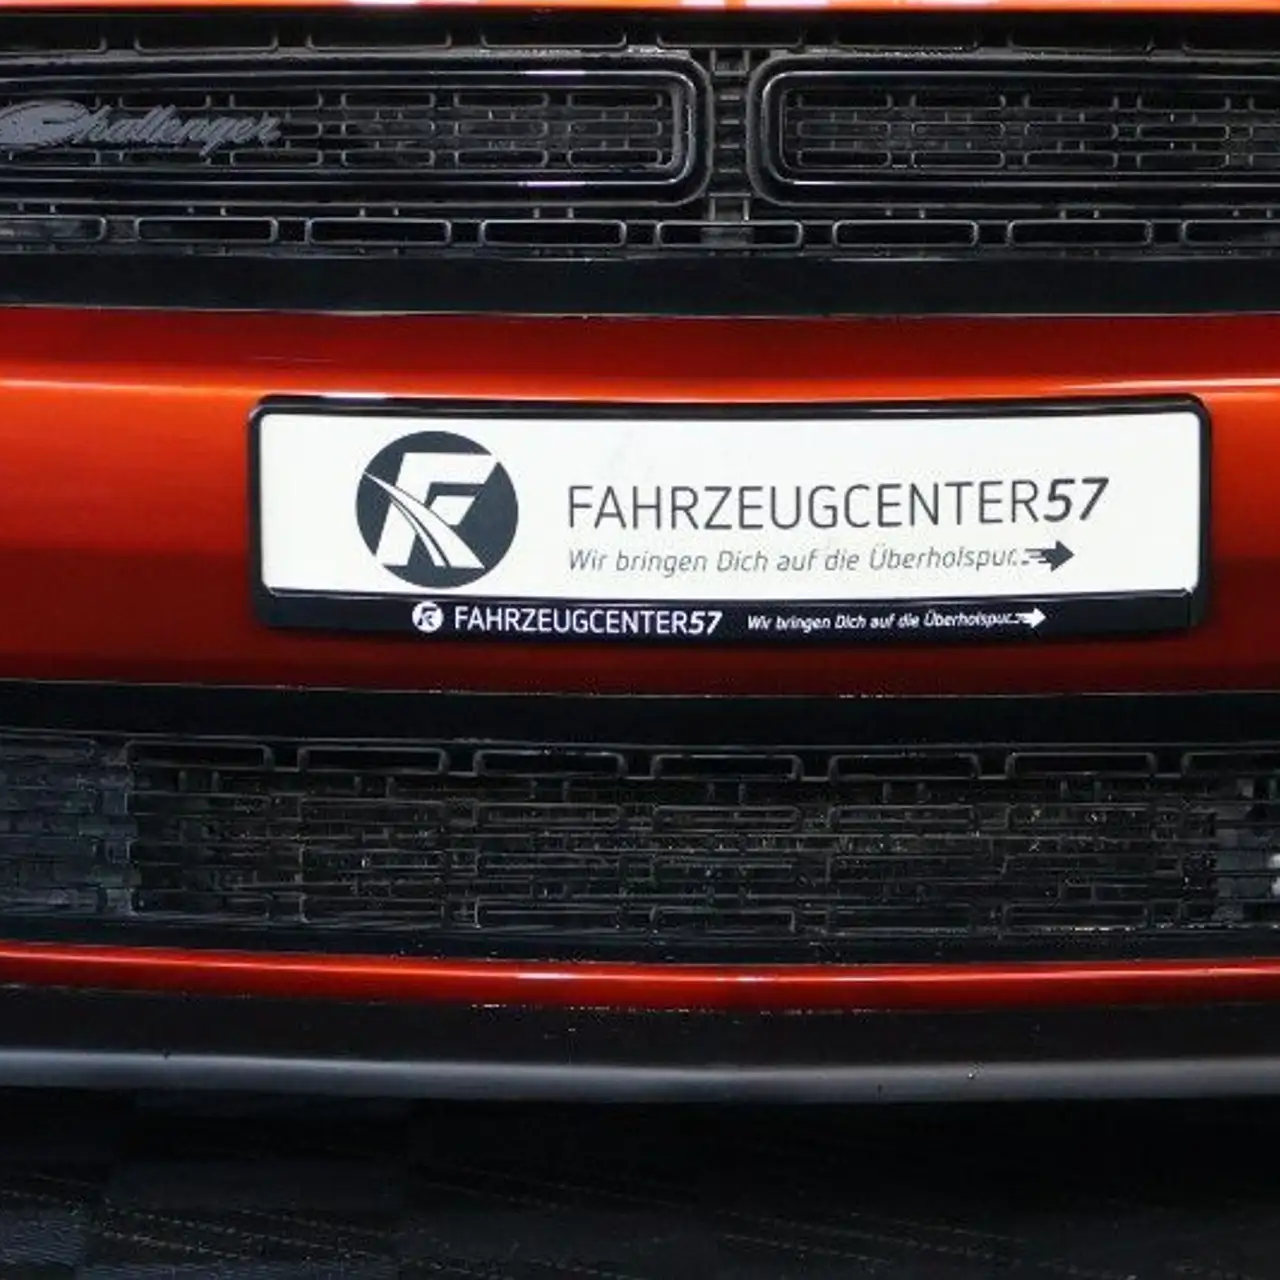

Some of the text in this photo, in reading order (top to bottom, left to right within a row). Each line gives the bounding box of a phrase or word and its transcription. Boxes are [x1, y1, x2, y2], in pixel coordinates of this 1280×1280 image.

[567, 477, 1110, 530] FAHRZEUGCENTER57
[568, 549, 608, 571] Wir
[615, 549, 708, 578] bringen
[716, 550, 769, 572] Dich
[777, 548, 820, 571] auf
[824, 549, 860, 572] die
[454, 605, 723, 634] FAHRZEUGCENTER57
[747, 614, 769, 630] Wir
[776, 615, 831, 633] bringen
[835, 615, 867, 629] Dich
[870, 613, 896, 629] auf
[898, 612, 920, 628] die
